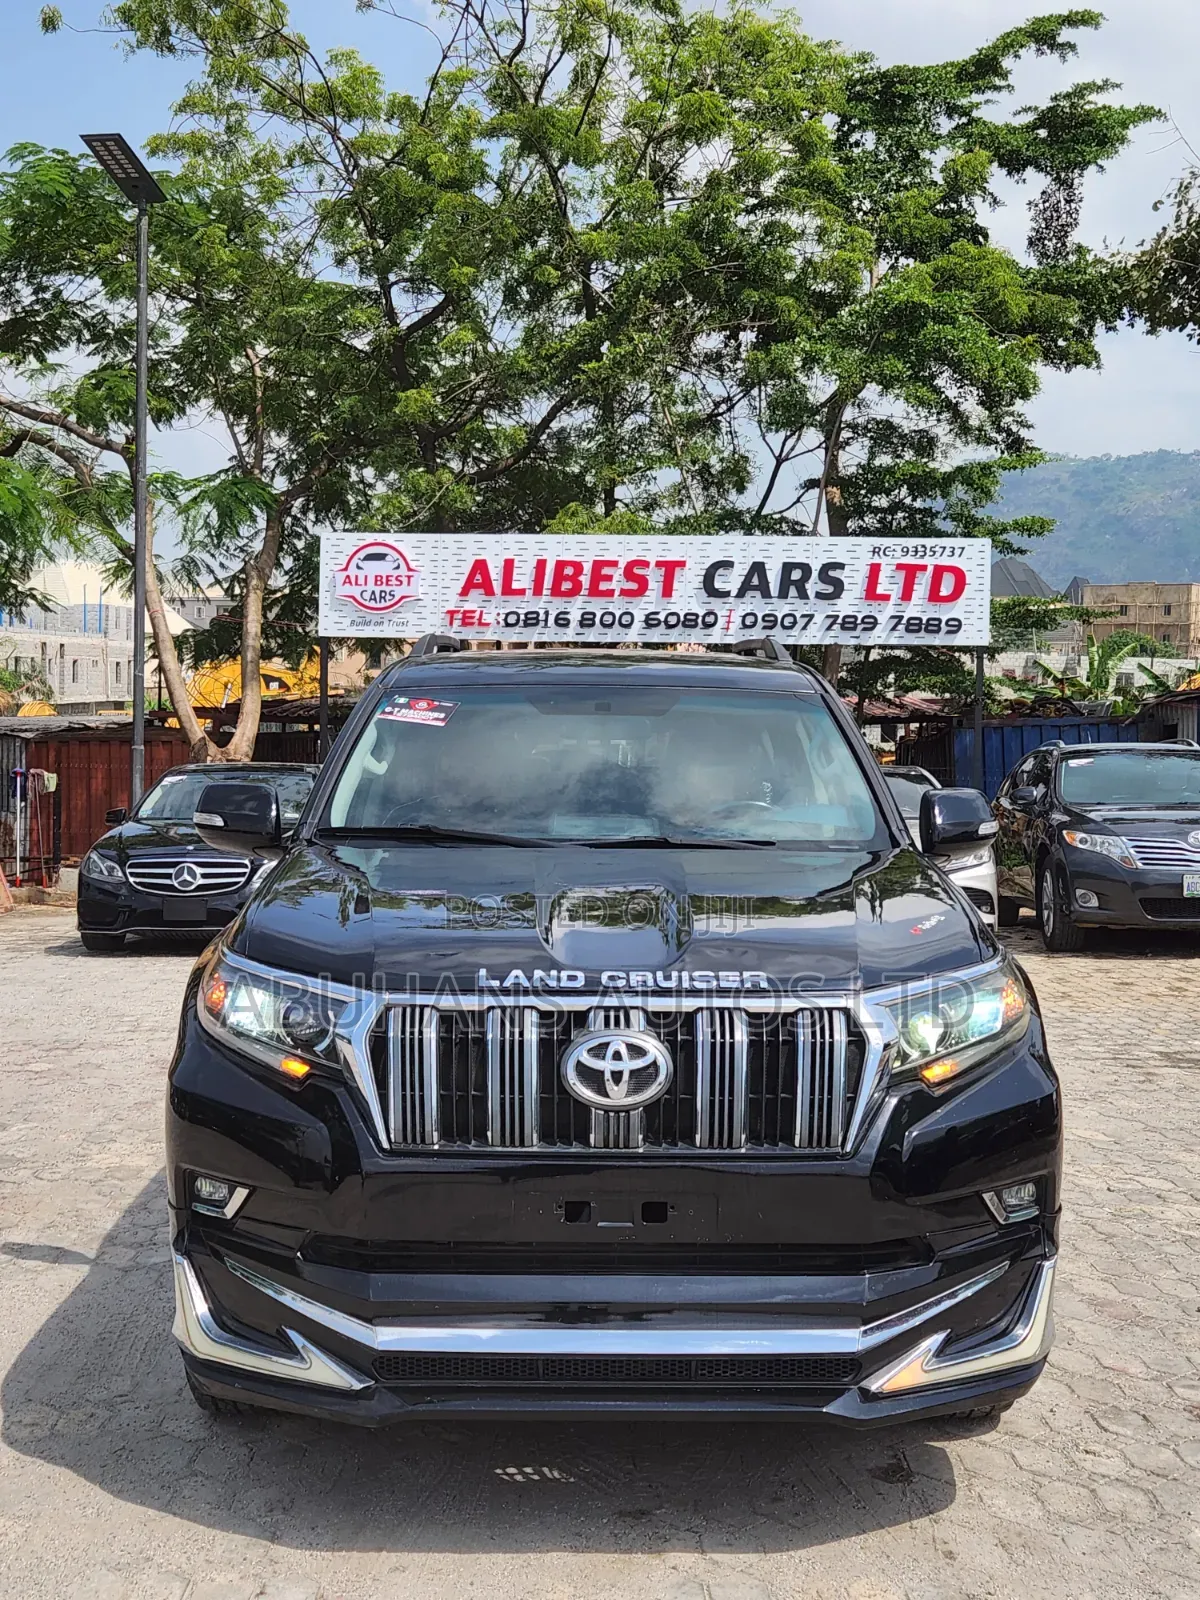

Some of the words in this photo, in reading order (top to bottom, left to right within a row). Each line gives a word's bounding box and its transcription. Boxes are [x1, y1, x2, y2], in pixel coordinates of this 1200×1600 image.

[901, 545, 966, 558] 9335737
[342, 575, 368, 587] ALI
[374, 575, 414, 587] BEST
[459, 558, 687, 598] ALIBEST
[702, 560, 846, 601] CARS
[863, 562, 967, 604] LTD
[360, 590, 396, 604] CARS
[349, 619, 373, 627] Build
[504, 610, 571, 628] 0816
[578, 611, 635, 629] 800
[644, 611, 719, 630] 6080
[741, 612, 815, 631] 0907
[824, 614, 878, 632] 789
[888, 614, 963, 635] 7889
[478, 968, 586, 989] LAND
[600, 970, 769, 989] CRUISER
